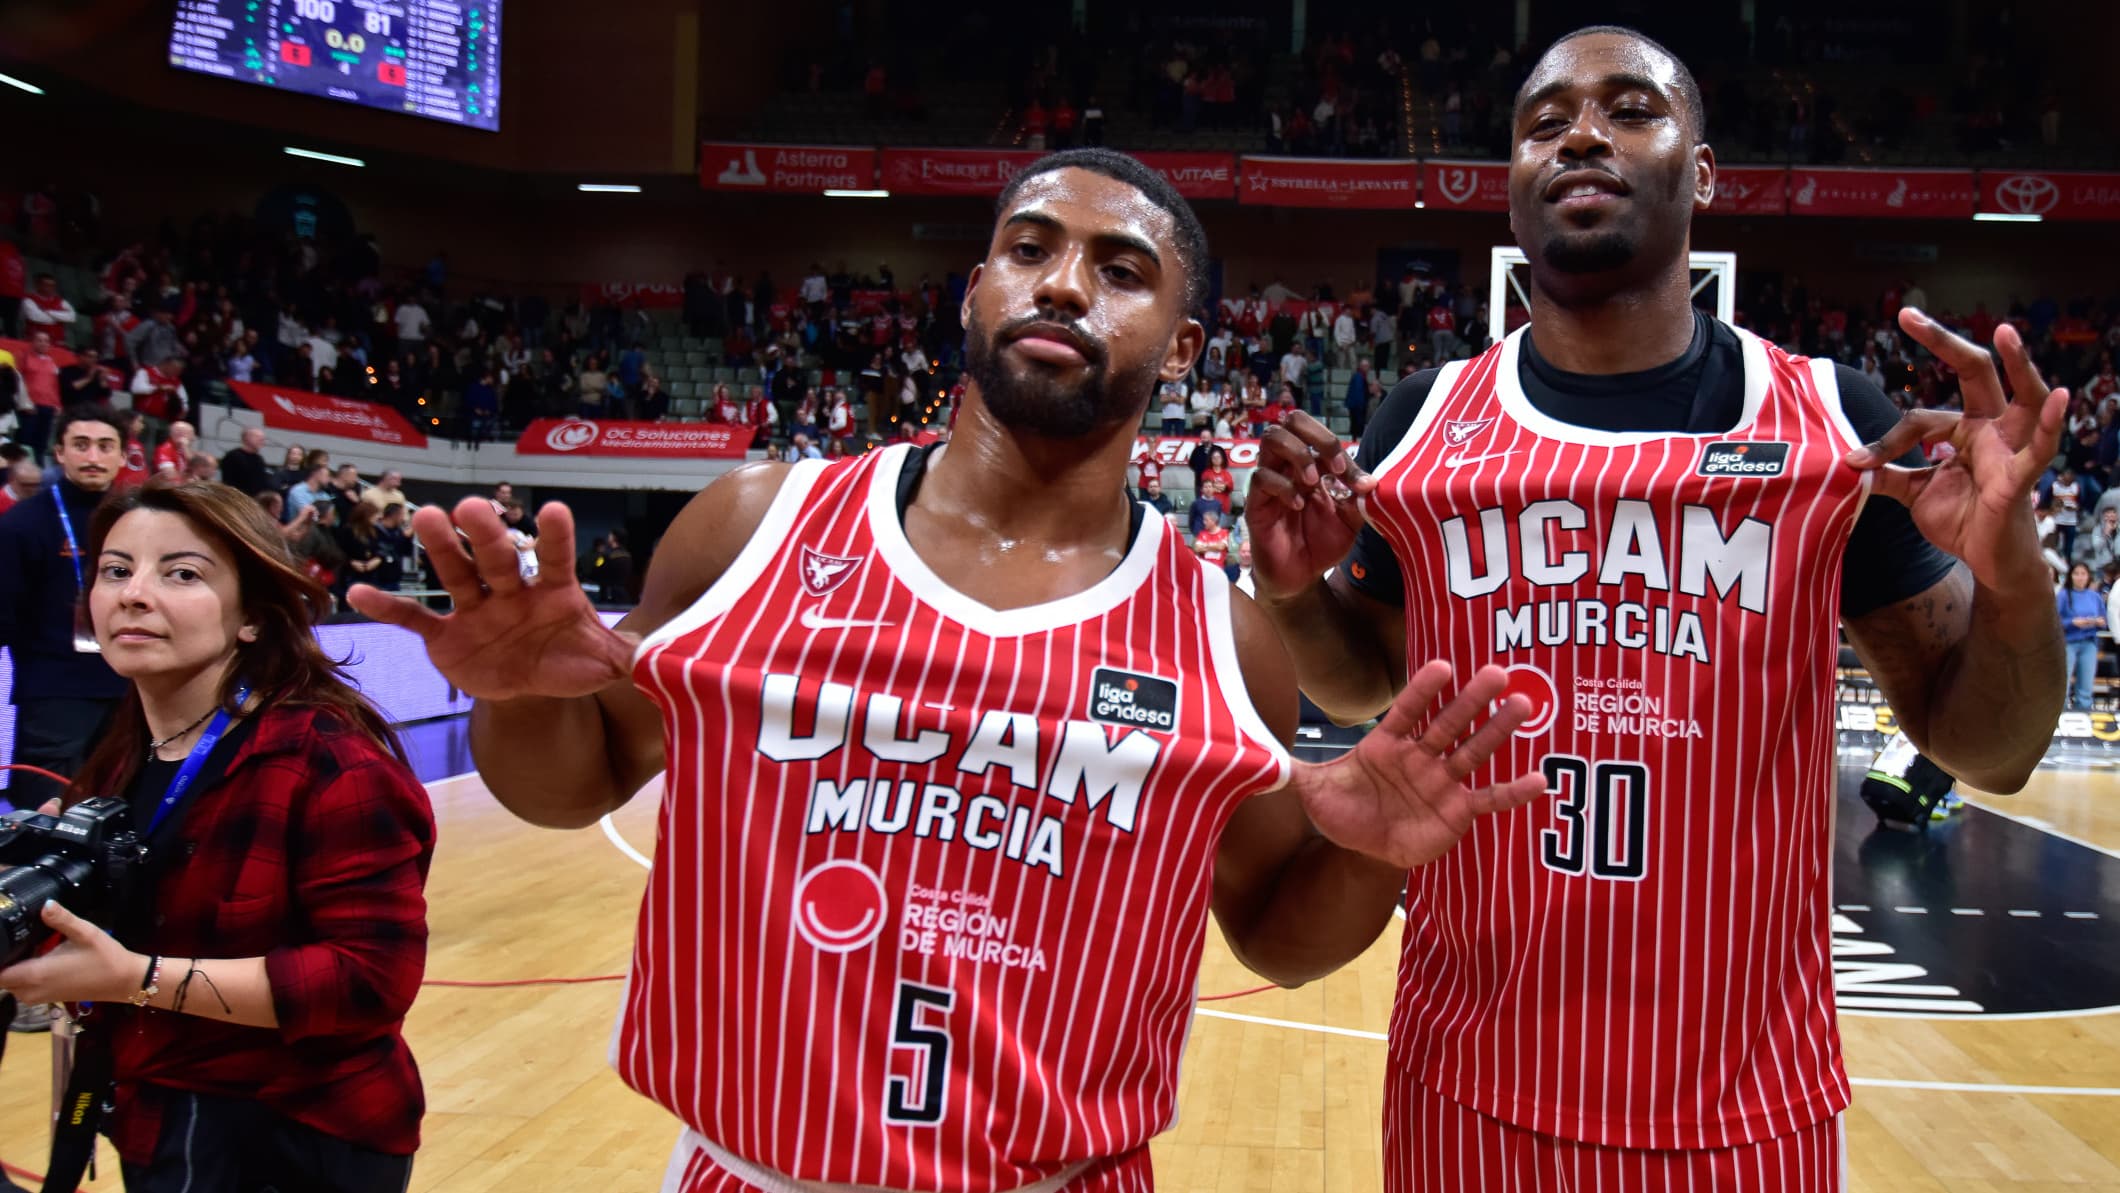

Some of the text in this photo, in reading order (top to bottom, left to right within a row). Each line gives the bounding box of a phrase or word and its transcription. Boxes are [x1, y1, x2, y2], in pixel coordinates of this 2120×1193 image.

[294, 0, 335, 23] 100
[364, 10, 390, 36] 81
[325, 28, 365, 53] 0.0
[775, 152, 848, 168] Asterra
[773, 171, 857, 188] Partners
[1172, 168, 1228, 181] VITAE
[1270, 178, 1338, 190] ESTRELLA
[1350, 180, 1409, 191] LEVANTE
[606, 429, 731, 442] OC Soluciones
[1705, 460, 1780, 472] endesa
[1709, 452, 1744, 464] liga
[1440, 497, 1772, 615] UCAM
[1495, 598, 1711, 663] MURCIA
[1099, 683, 1134, 703] liga
[1574, 676, 1643, 689] Costa Cálida
[1096, 702, 1171, 726] endesa
[1574, 692, 1661, 715] REGIÓN
[1574, 714, 1702, 738] DE MURCIA
[756, 673, 1162, 833] UCAM
[806, 779, 1064, 878] MURCIA
[1539, 753, 1649, 882] 30
[910, 884, 948, 900] Costa
[903, 904, 1007, 938] REGIÓN
[901, 929, 1046, 972] DE MURCIA
[882, 979, 955, 1127] 5
[70, 1092, 93, 1125] Nikon
